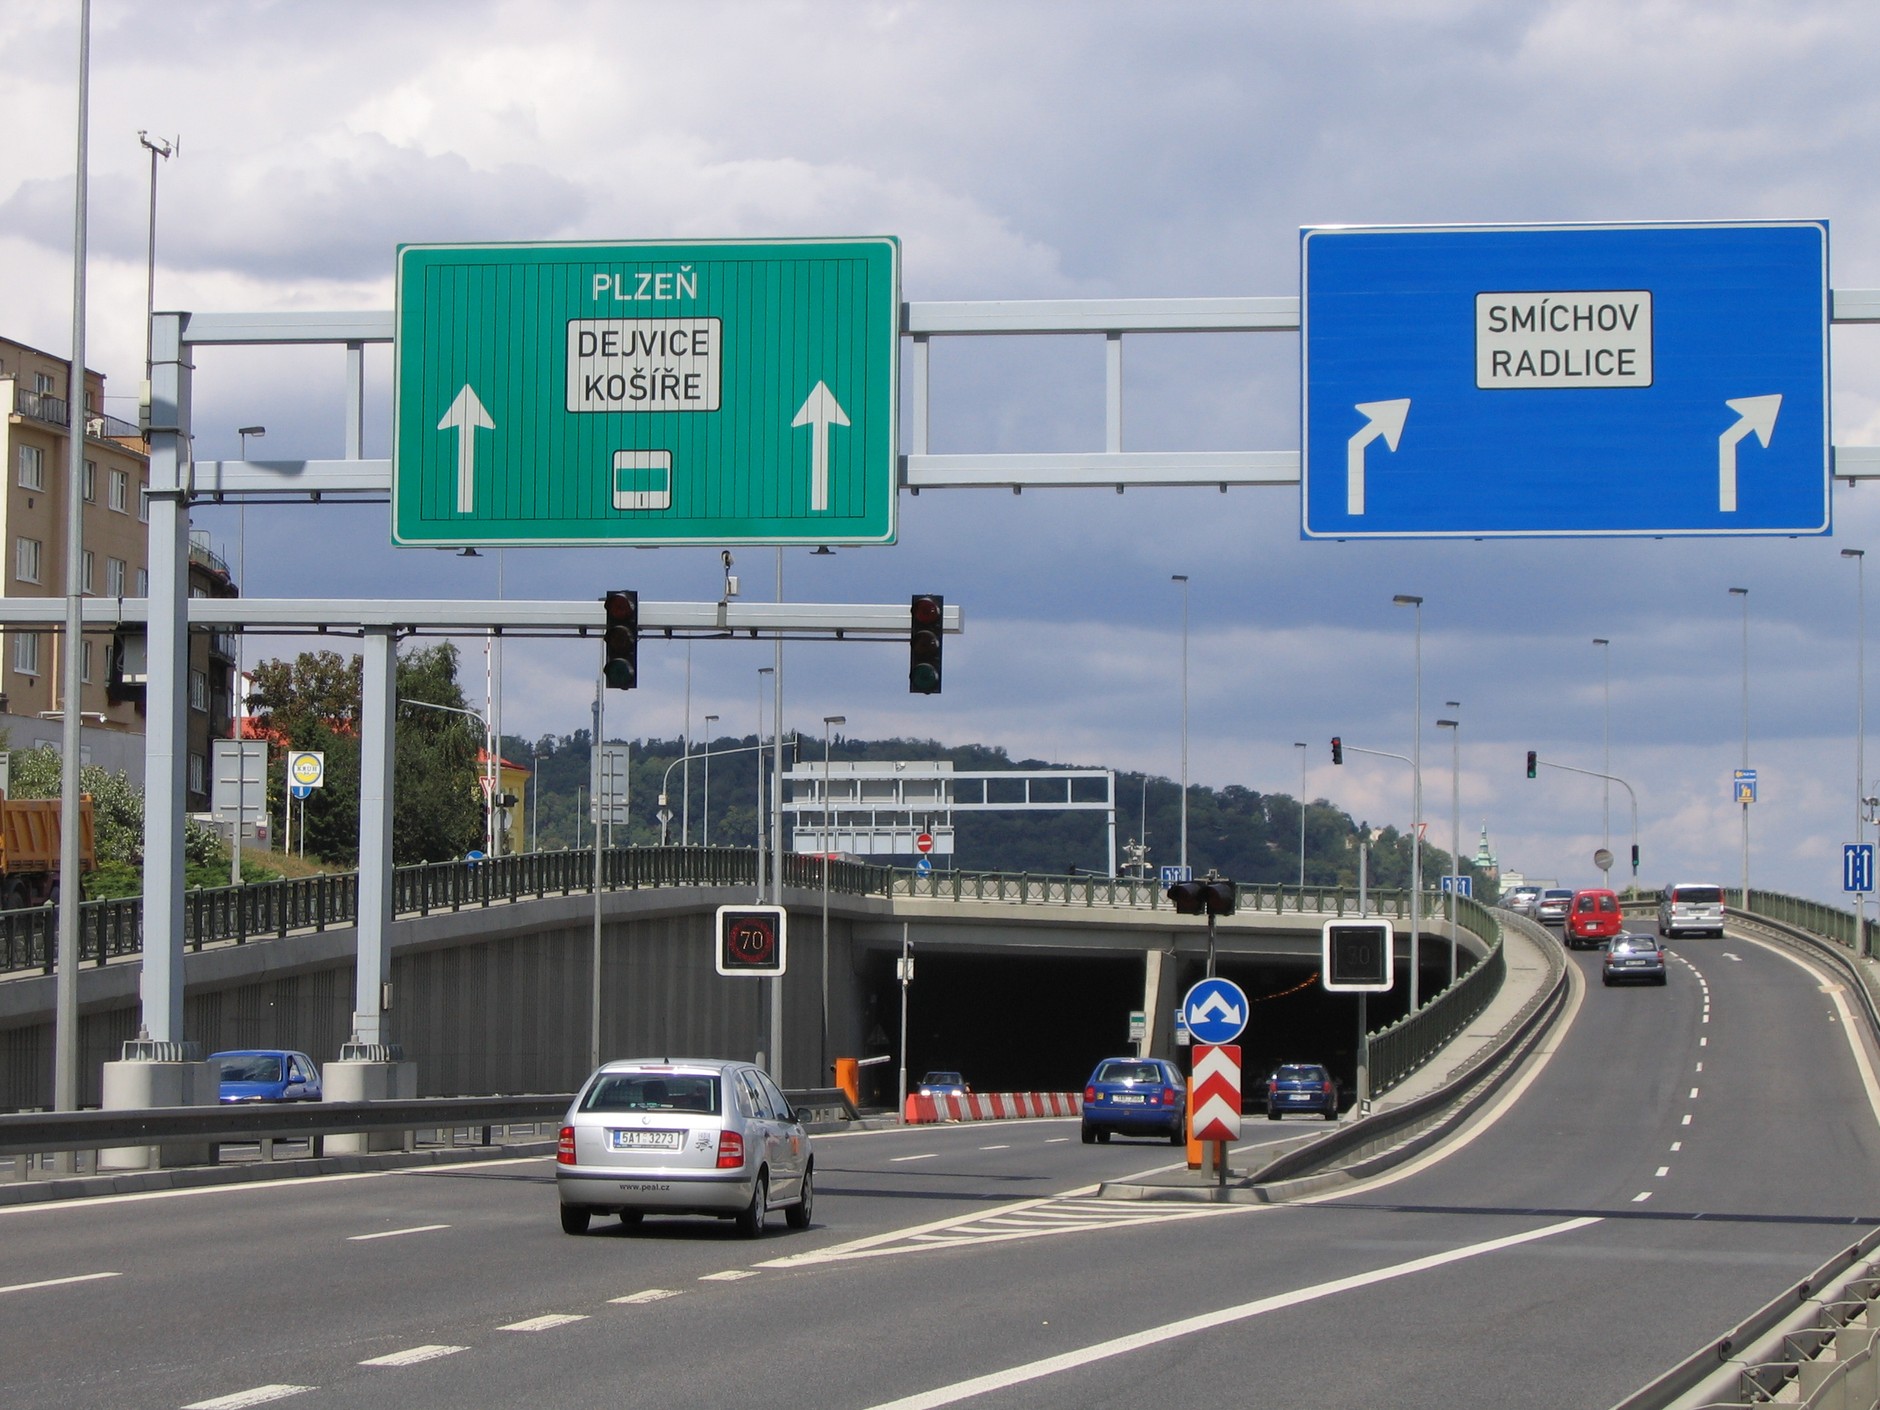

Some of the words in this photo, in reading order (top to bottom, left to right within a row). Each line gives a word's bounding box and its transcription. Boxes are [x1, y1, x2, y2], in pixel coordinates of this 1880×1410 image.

[592, 266, 698, 301] PLZEŇ
[1488, 298, 1639, 333] SMÍCHOV
[578, 330, 709, 358] DEJVICE
[1492, 348, 1636, 377] RADLICE
[585, 367, 702, 401] KOŠÍŘE
[740, 930, 763, 950] 70
[622, 1133, 641, 1144] 5A1
[649, 1133, 674, 1144] 3273
